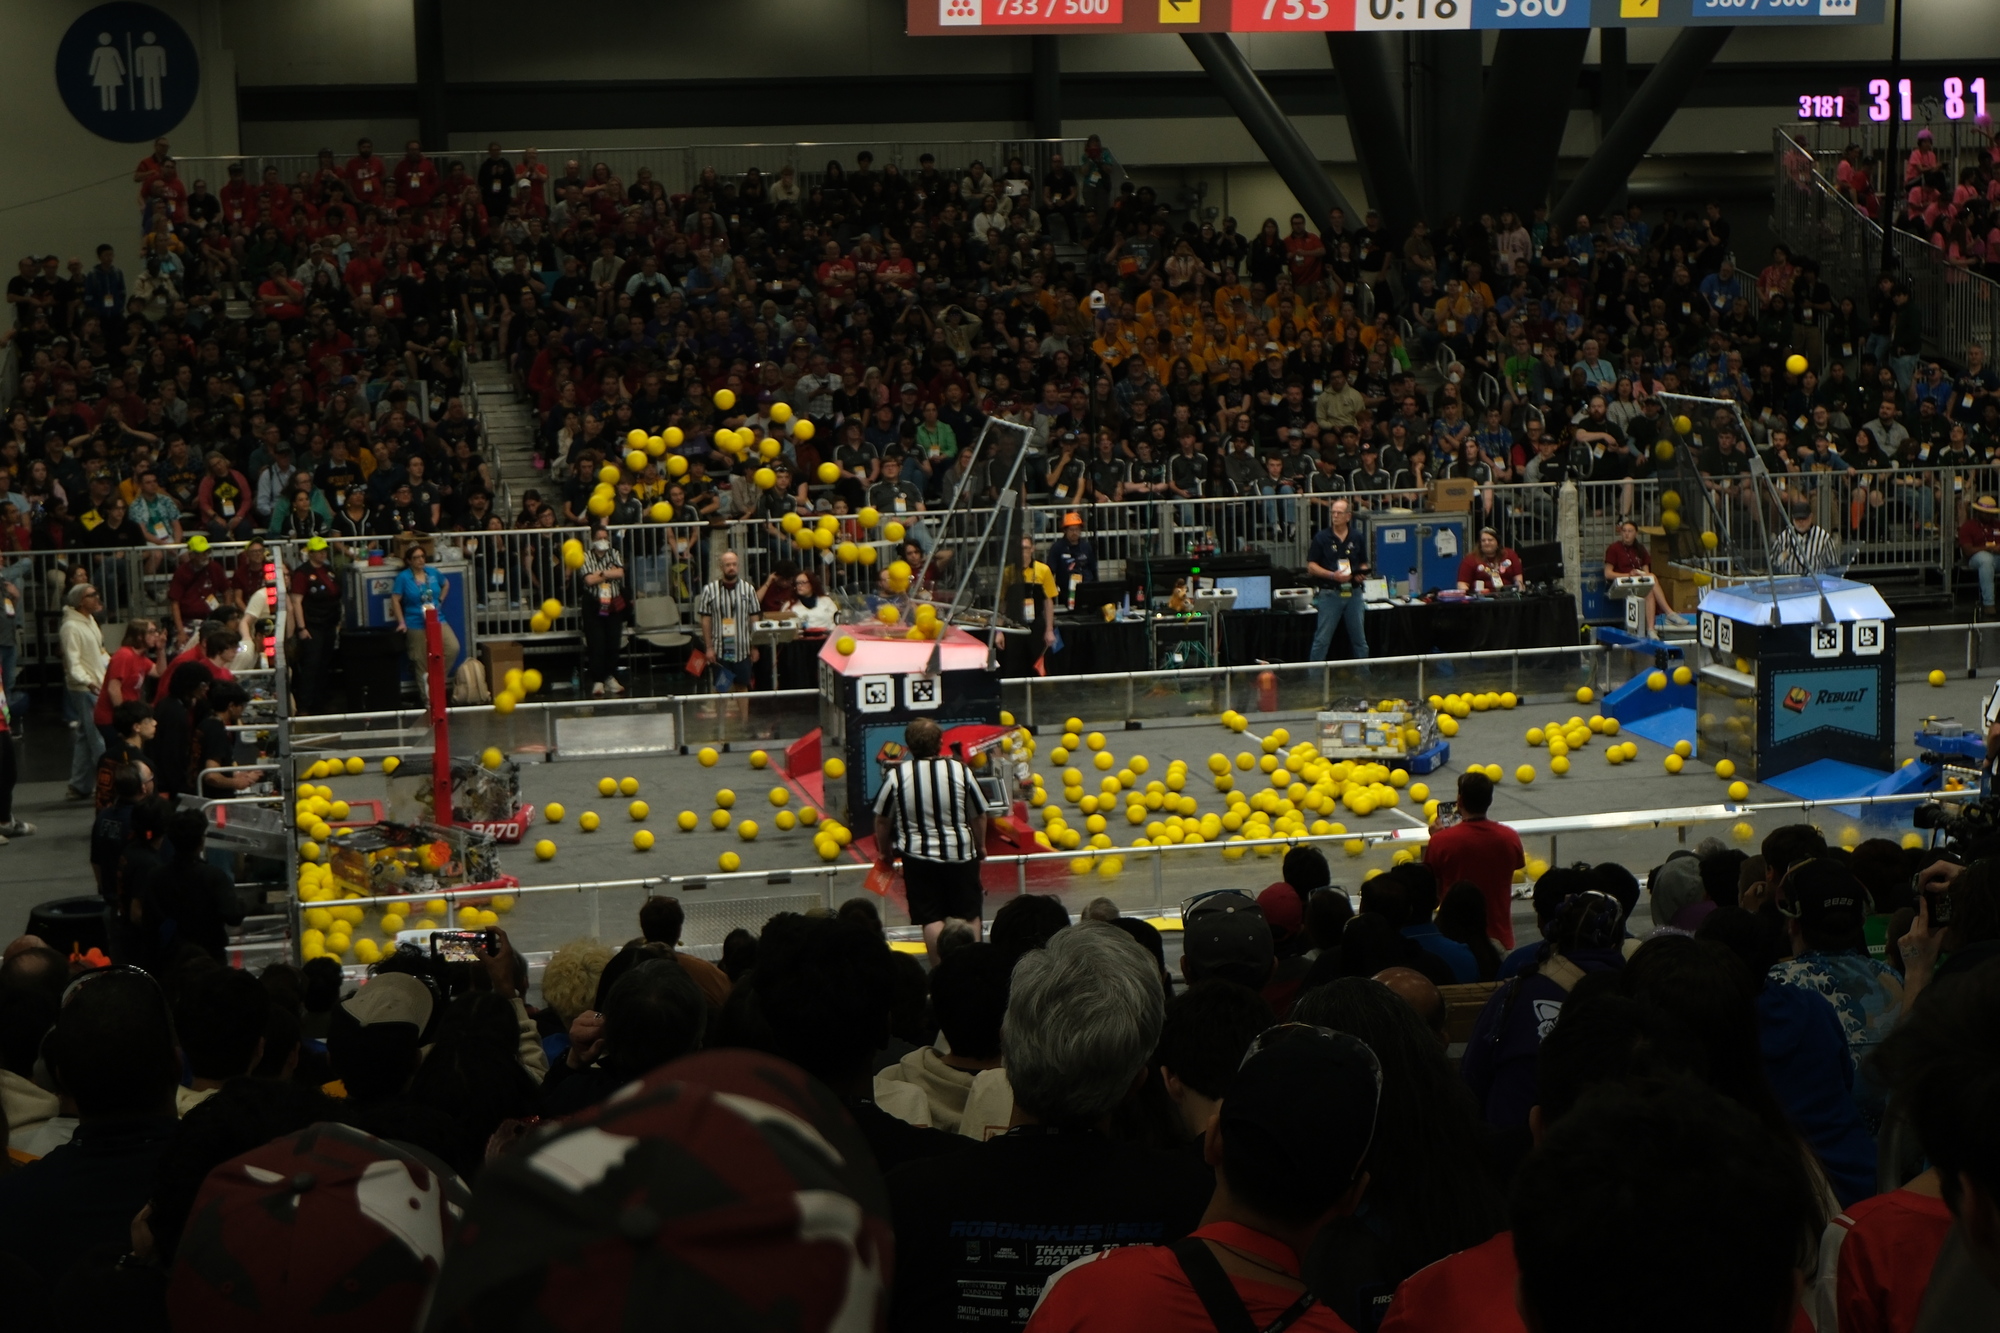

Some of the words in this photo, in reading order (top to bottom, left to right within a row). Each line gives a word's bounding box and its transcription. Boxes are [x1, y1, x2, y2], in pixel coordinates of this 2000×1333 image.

[996, 0, 1039, 15] 733
[1065, 0, 1109, 15] 500
[1798, 94, 1845, 118] 3181
[1815, 687, 1868, 705] REBUILT
[1035, 1244, 1094, 1256] THANKS
[1033, 1256, 1069, 1266] 2026
[963, 1288, 1002, 1296] FOUNDATION
[957, 1304, 1009, 1317] SMITH+GARDNER
